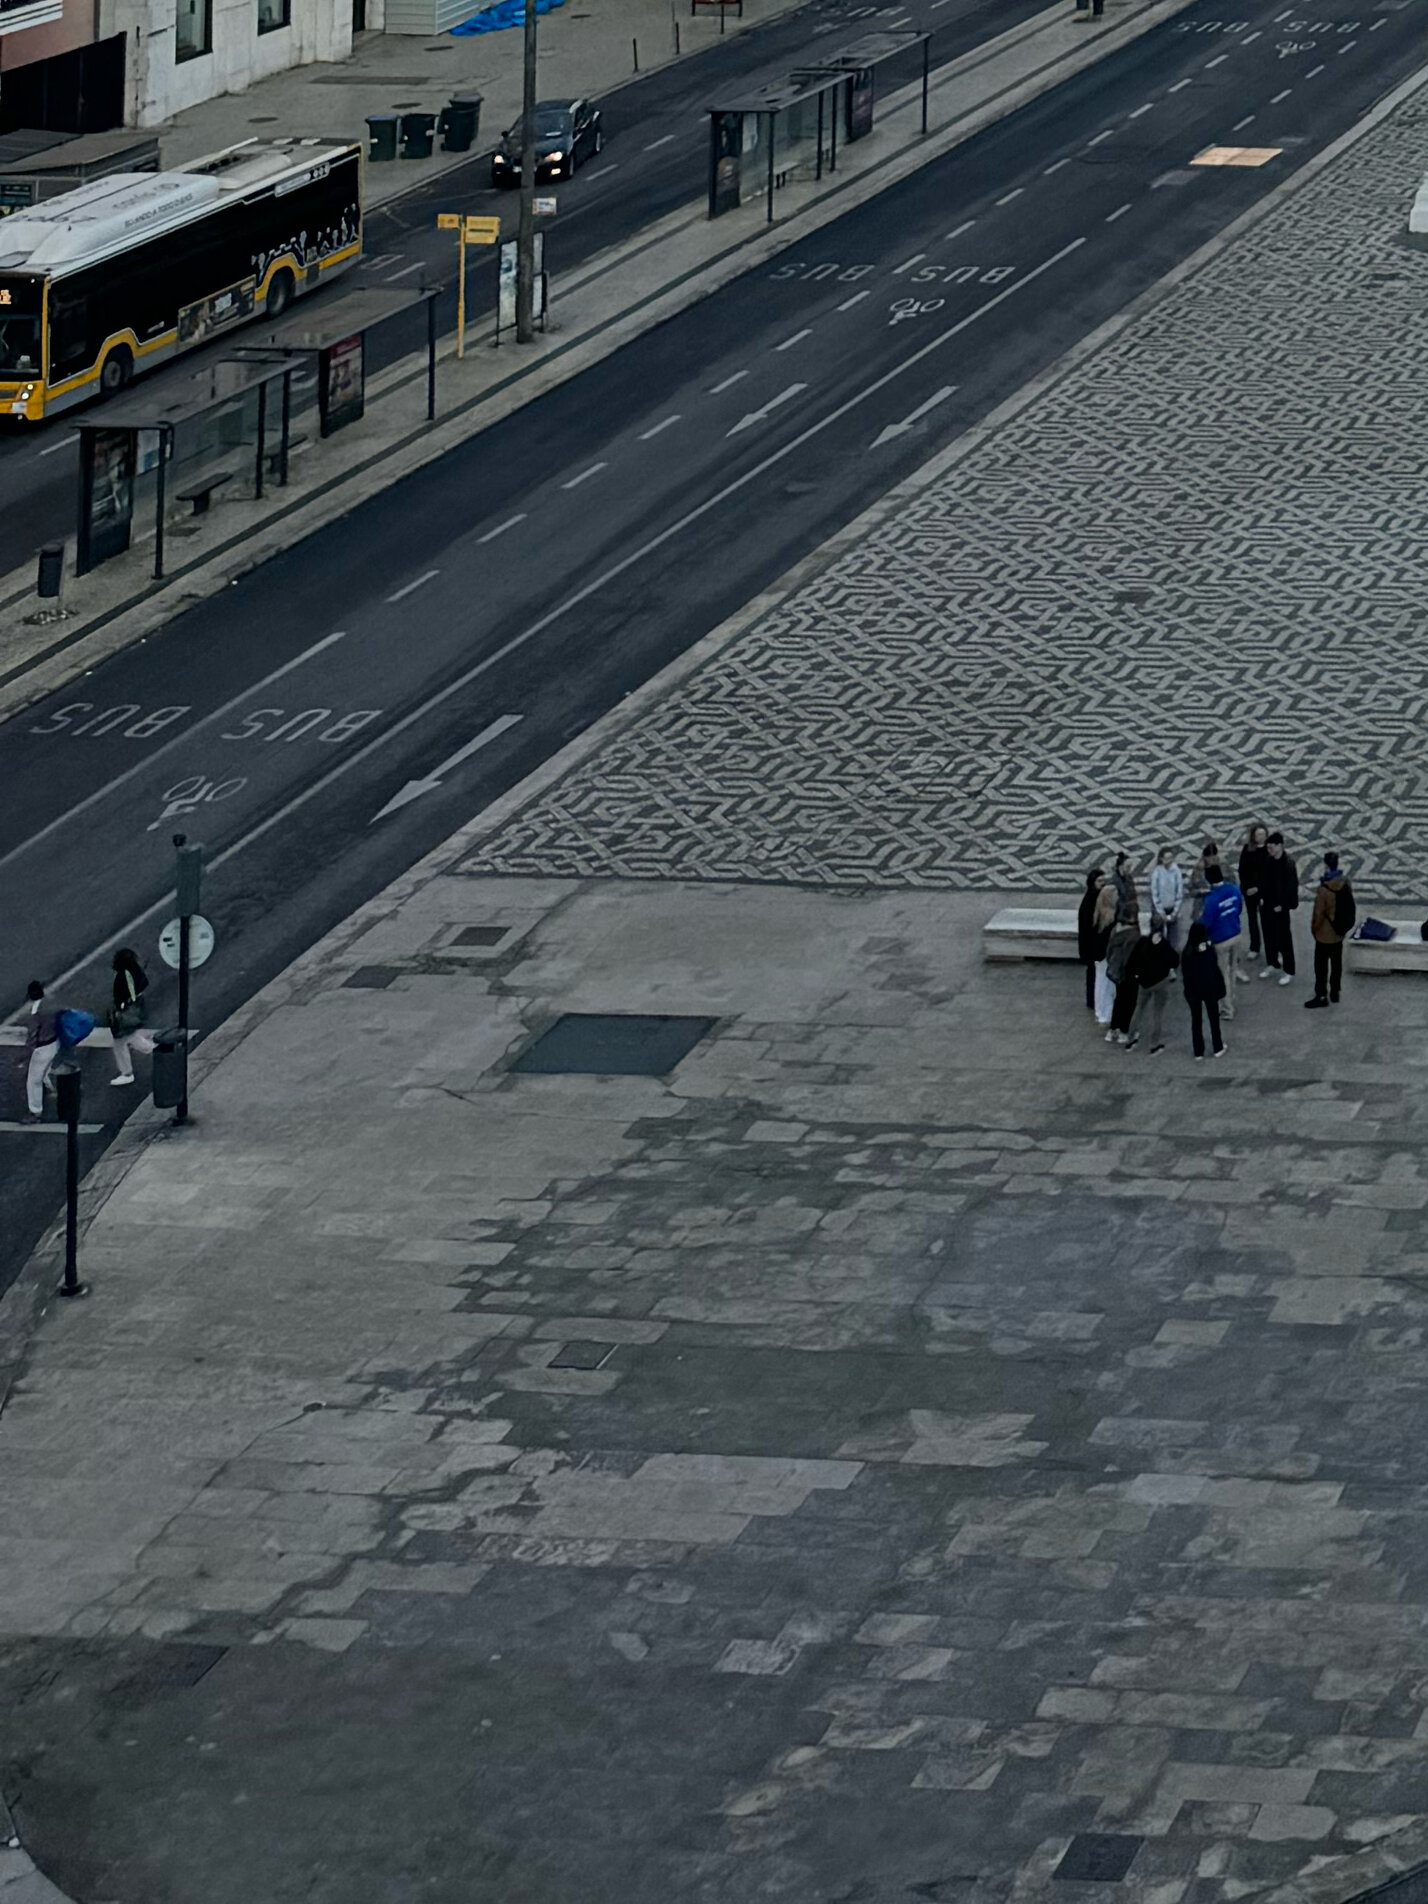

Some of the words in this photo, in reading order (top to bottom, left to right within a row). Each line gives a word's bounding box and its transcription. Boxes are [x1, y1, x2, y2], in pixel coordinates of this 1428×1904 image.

[911, 265, 1016, 284] BUS
[28, 703, 192, 738] BUS
[220, 708, 384, 742] BUS
